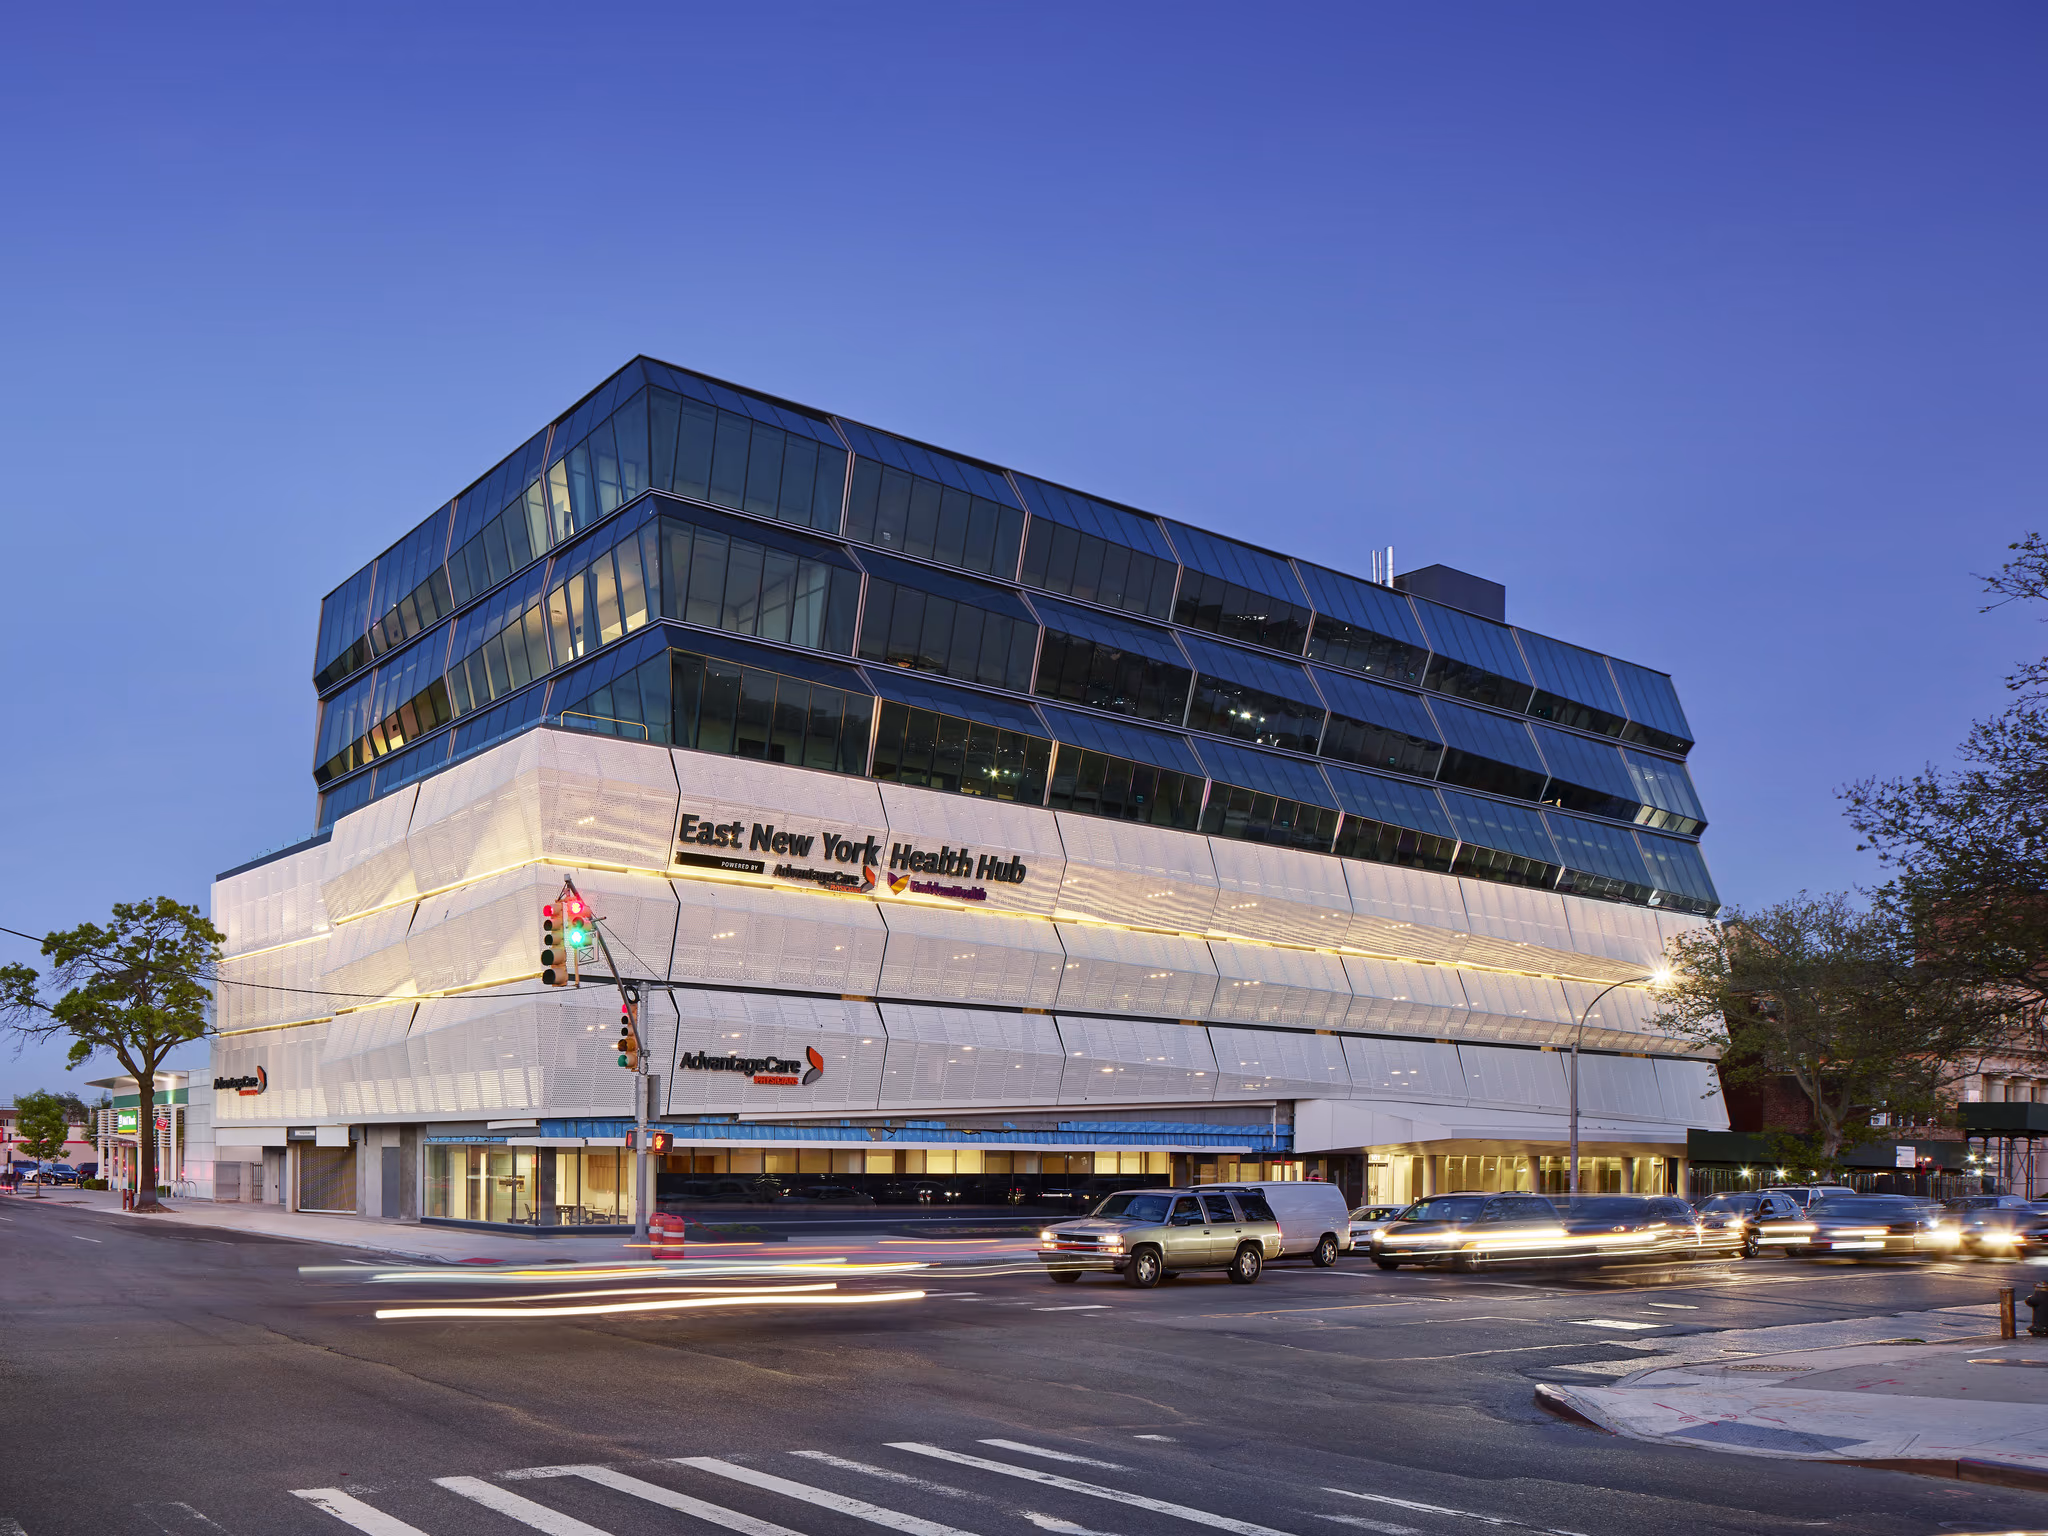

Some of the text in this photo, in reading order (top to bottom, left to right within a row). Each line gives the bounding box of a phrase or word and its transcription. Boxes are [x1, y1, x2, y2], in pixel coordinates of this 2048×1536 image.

[679, 813, 1027, 884] East New York Health Hub
[721, 861, 750, 870] POWERED
[773, 863, 860, 885] AdvantageCare
[829, 884, 862, 894] PHYSICIANS
[680, 1050, 802, 1077] AdvantageCare
[753, 1075, 799, 1086] PHYSICIANS
